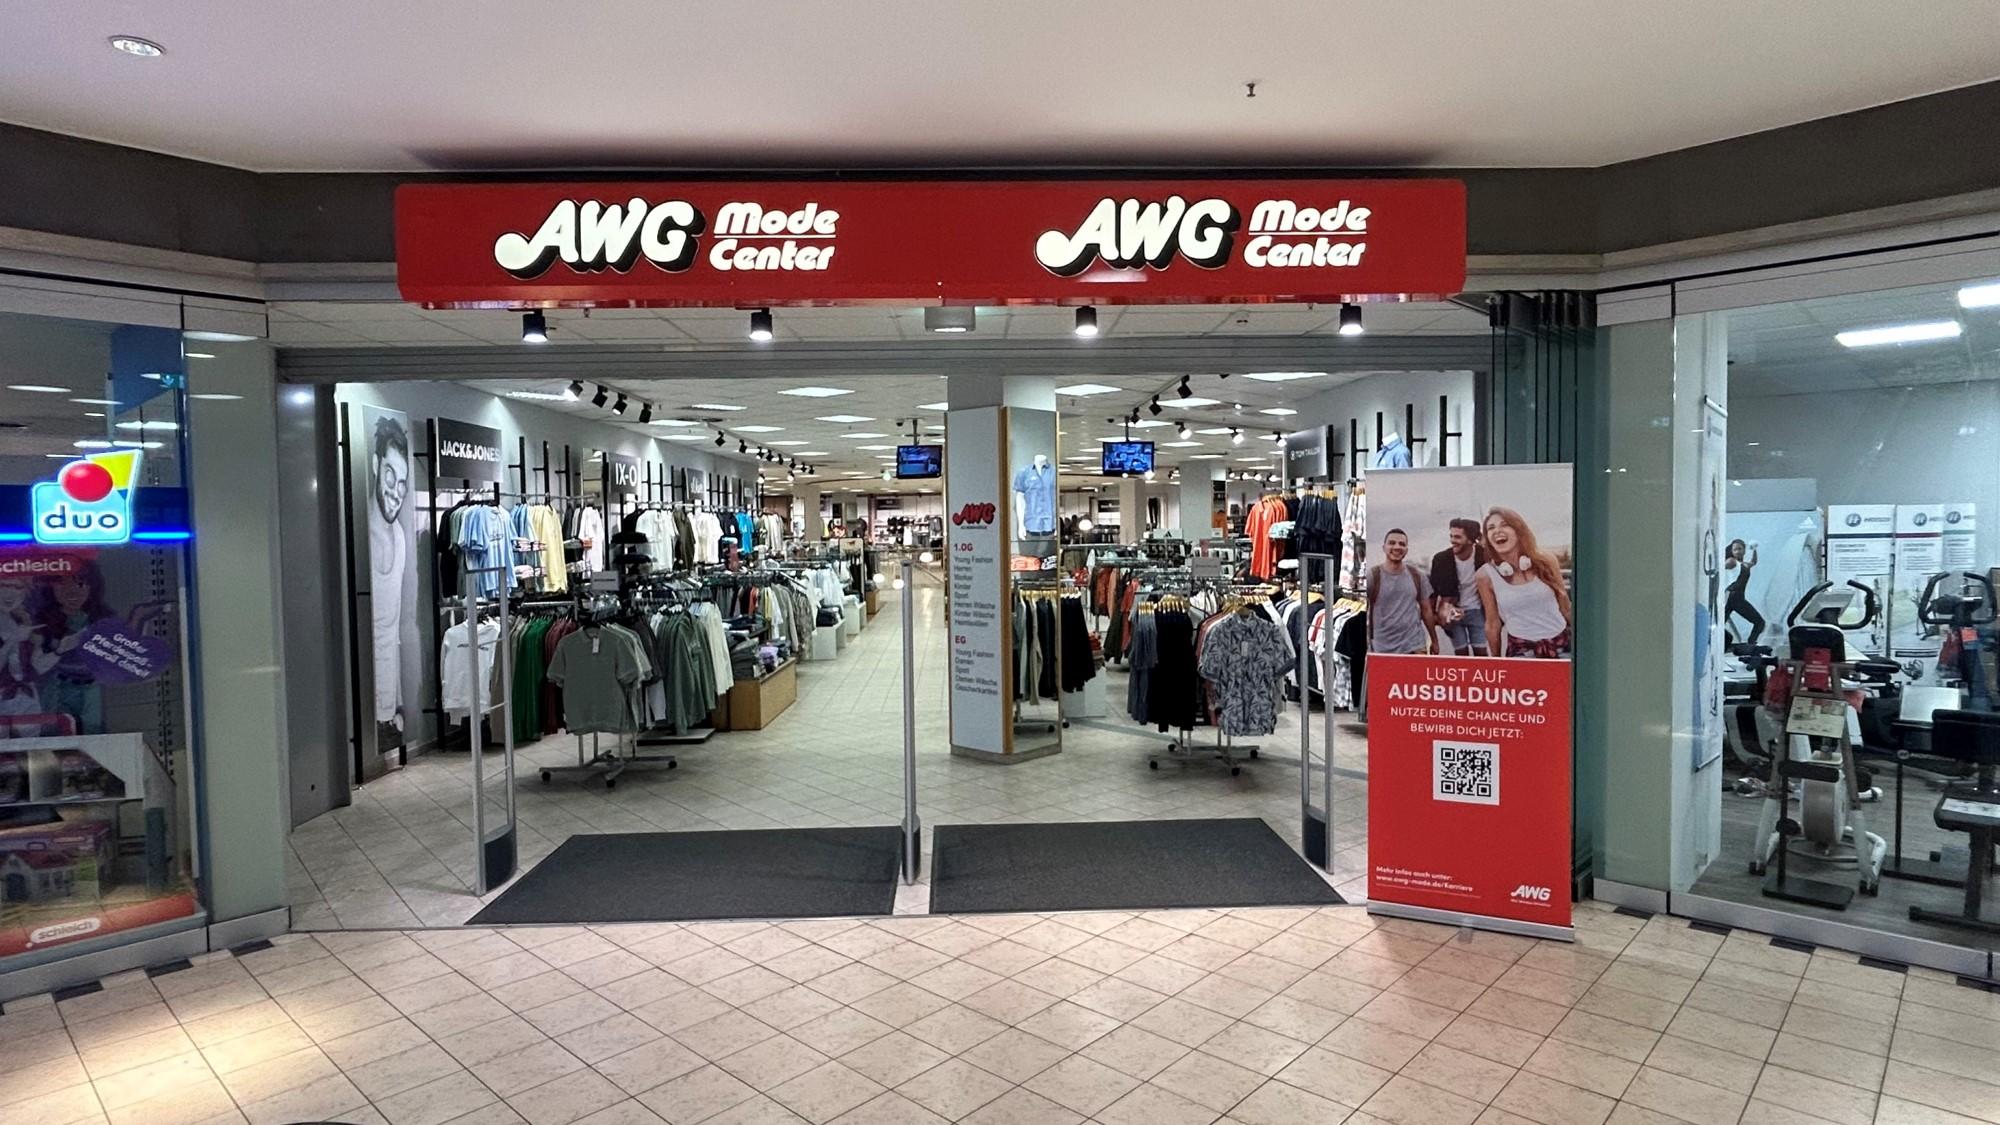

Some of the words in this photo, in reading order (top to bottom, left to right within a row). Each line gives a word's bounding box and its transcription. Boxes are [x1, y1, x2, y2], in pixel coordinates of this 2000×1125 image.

[713, 201, 840, 236] Mode
[1248, 199, 1372, 232] Mode
[494, 197, 706, 281] AWG
[1034, 195, 1242, 278] AWG
[709, 238, 836, 272] Center
[1243, 235, 1367, 268] Center
[45, 505, 119, 529] duo
[952, 502, 996, 526] AWG
[955, 635, 966, 644] EG
[1426, 667, 1469, 682] LUST
[1472, 669, 1507, 684] AUF
[1388, 683, 1548, 707] AUSBILDUNG?
[1390, 707, 1427, 718] NUTZE
[1430, 709, 1463, 720] DEINE
[1467, 711, 1516, 723] CHANCE
[1519, 714, 1546, 725] UND
[1410, 723, 1453, 735] BEWIRB
[1457, 725, 1486, 737] DICH
[1488, 727, 1525, 740] JETZT:
[1376, 866, 1394, 874] Mehr
[1511, 885, 1551, 901] AWG
[38, 920, 93, 940] schleich
